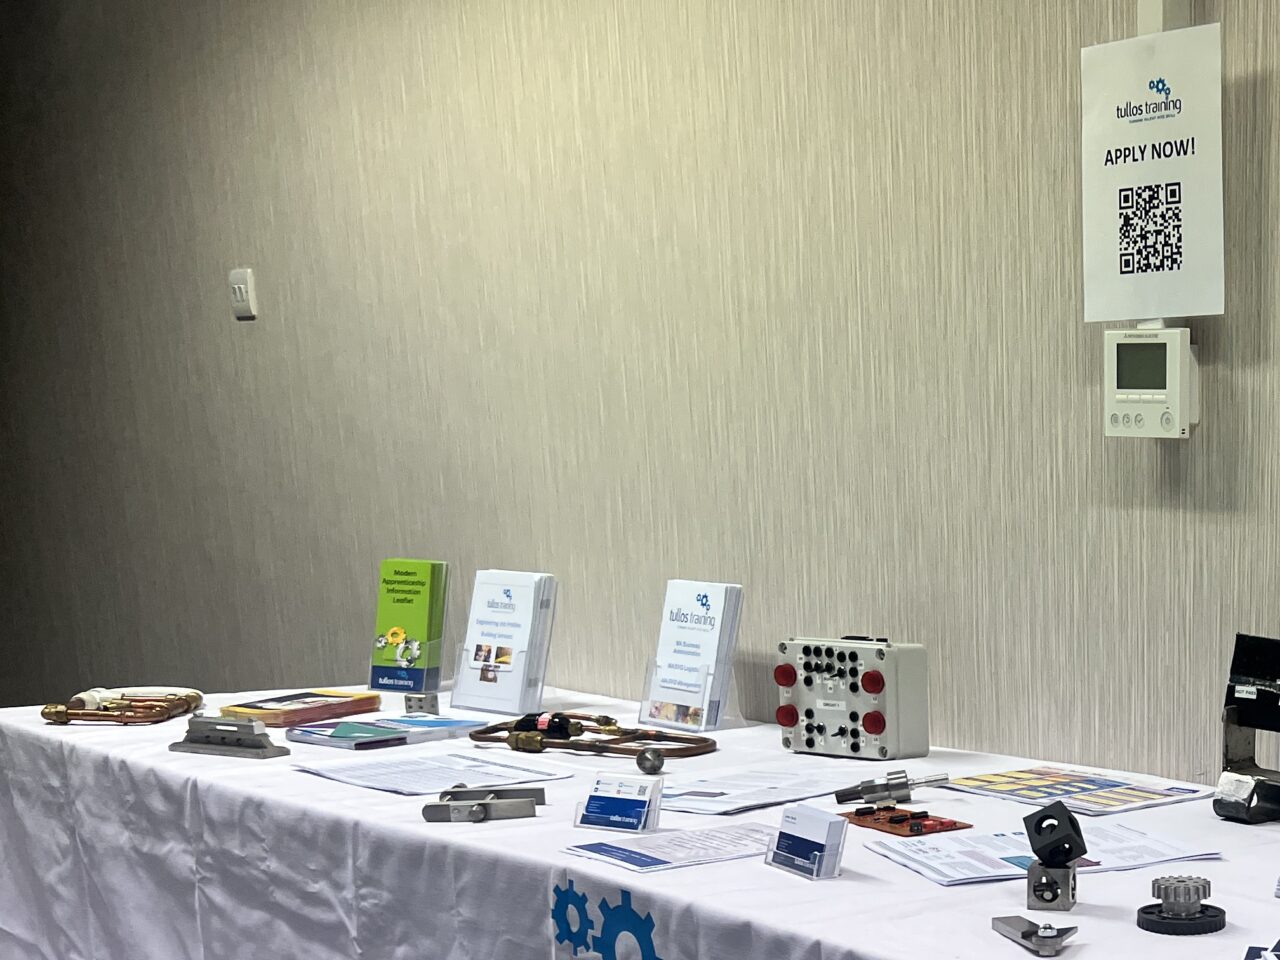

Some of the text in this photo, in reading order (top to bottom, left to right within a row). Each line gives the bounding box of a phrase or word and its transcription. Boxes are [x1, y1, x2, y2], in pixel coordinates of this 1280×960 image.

[1116, 101, 1144, 119] tullos
[1145, 97, 1182, 114] training
[1104, 137, 1195, 166] APPLY NOW!
[393, 569, 418, 577] Modern
[669, 608, 716, 630] tullos training
